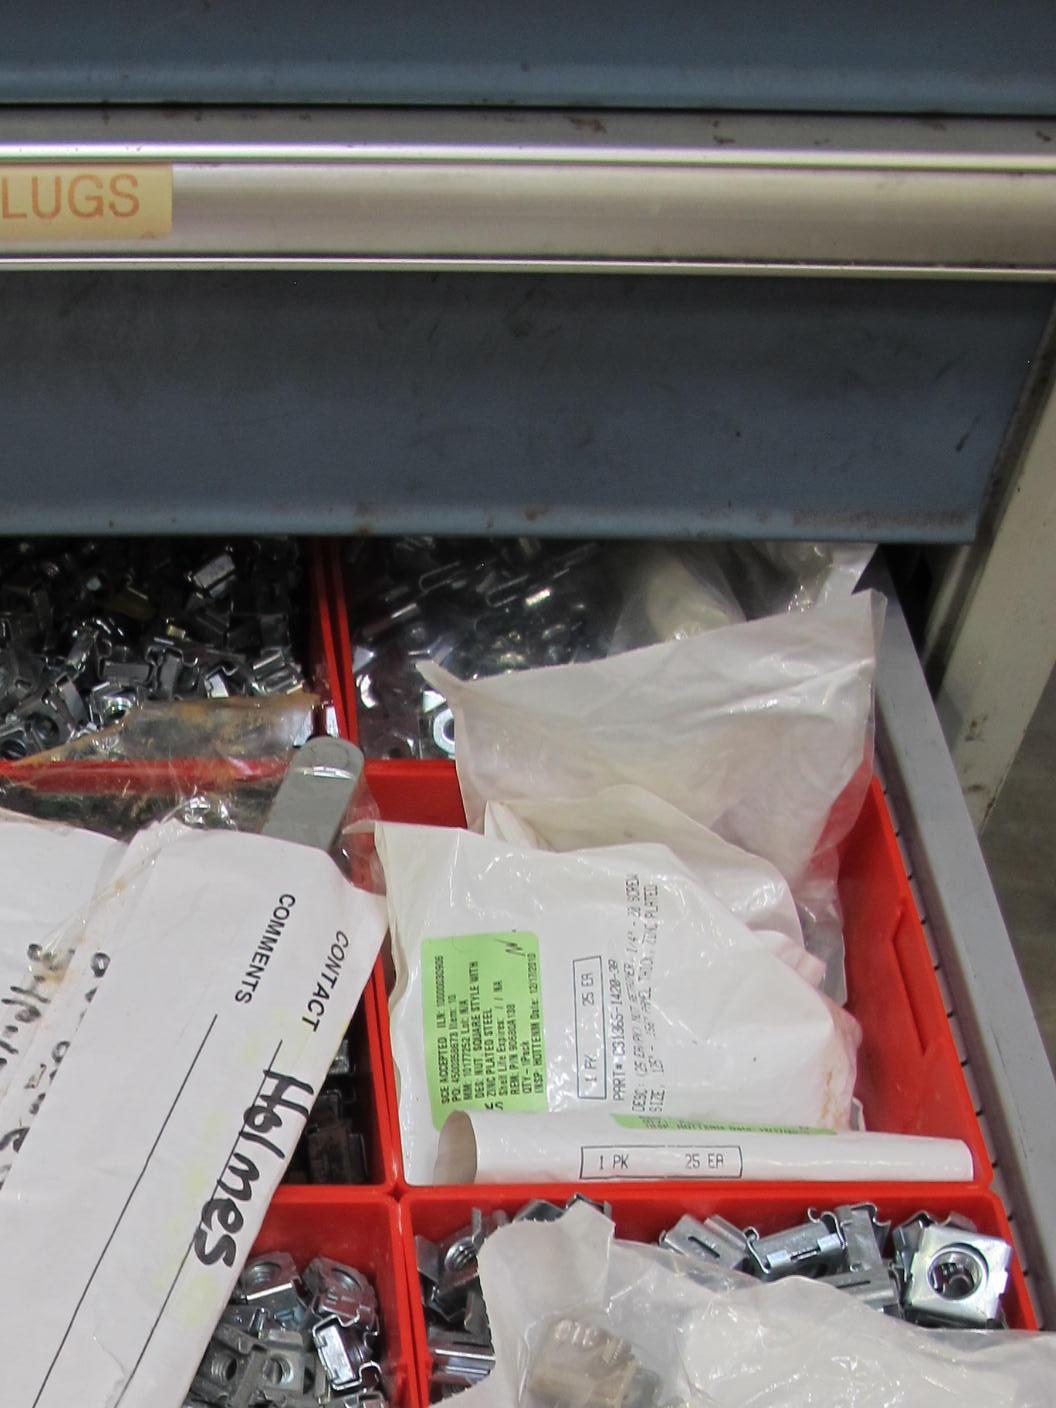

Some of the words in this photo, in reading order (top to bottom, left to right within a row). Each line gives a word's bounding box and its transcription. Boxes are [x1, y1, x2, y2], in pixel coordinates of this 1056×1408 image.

[0, 173, 141, 220] LUGS
[234, 893, 297, 1005] COMMENTS
[300, 930, 351, 1033] CONTACT
[468, 961, 479, 982] WITH
[580, 972, 595, 988] EA
[469, 984, 481, 1013] STYLE
[581, 991, 596, 1007] 25
[471, 1013, 483, 1052] SQUARE
[482, 1007, 494, 1037] STEEL
[437, 1036, 448, 1083] ACCEPTED
[484, 1039, 496, 1075] PLATED
[485, 1077, 497, 1098] ZINC
[193, 1068, 315, 1269] Holmes
[612, 1153, 630, 1169] PK
[684, 1153, 701, 1169] 25
[707, 1153, 725, 1169] EA
